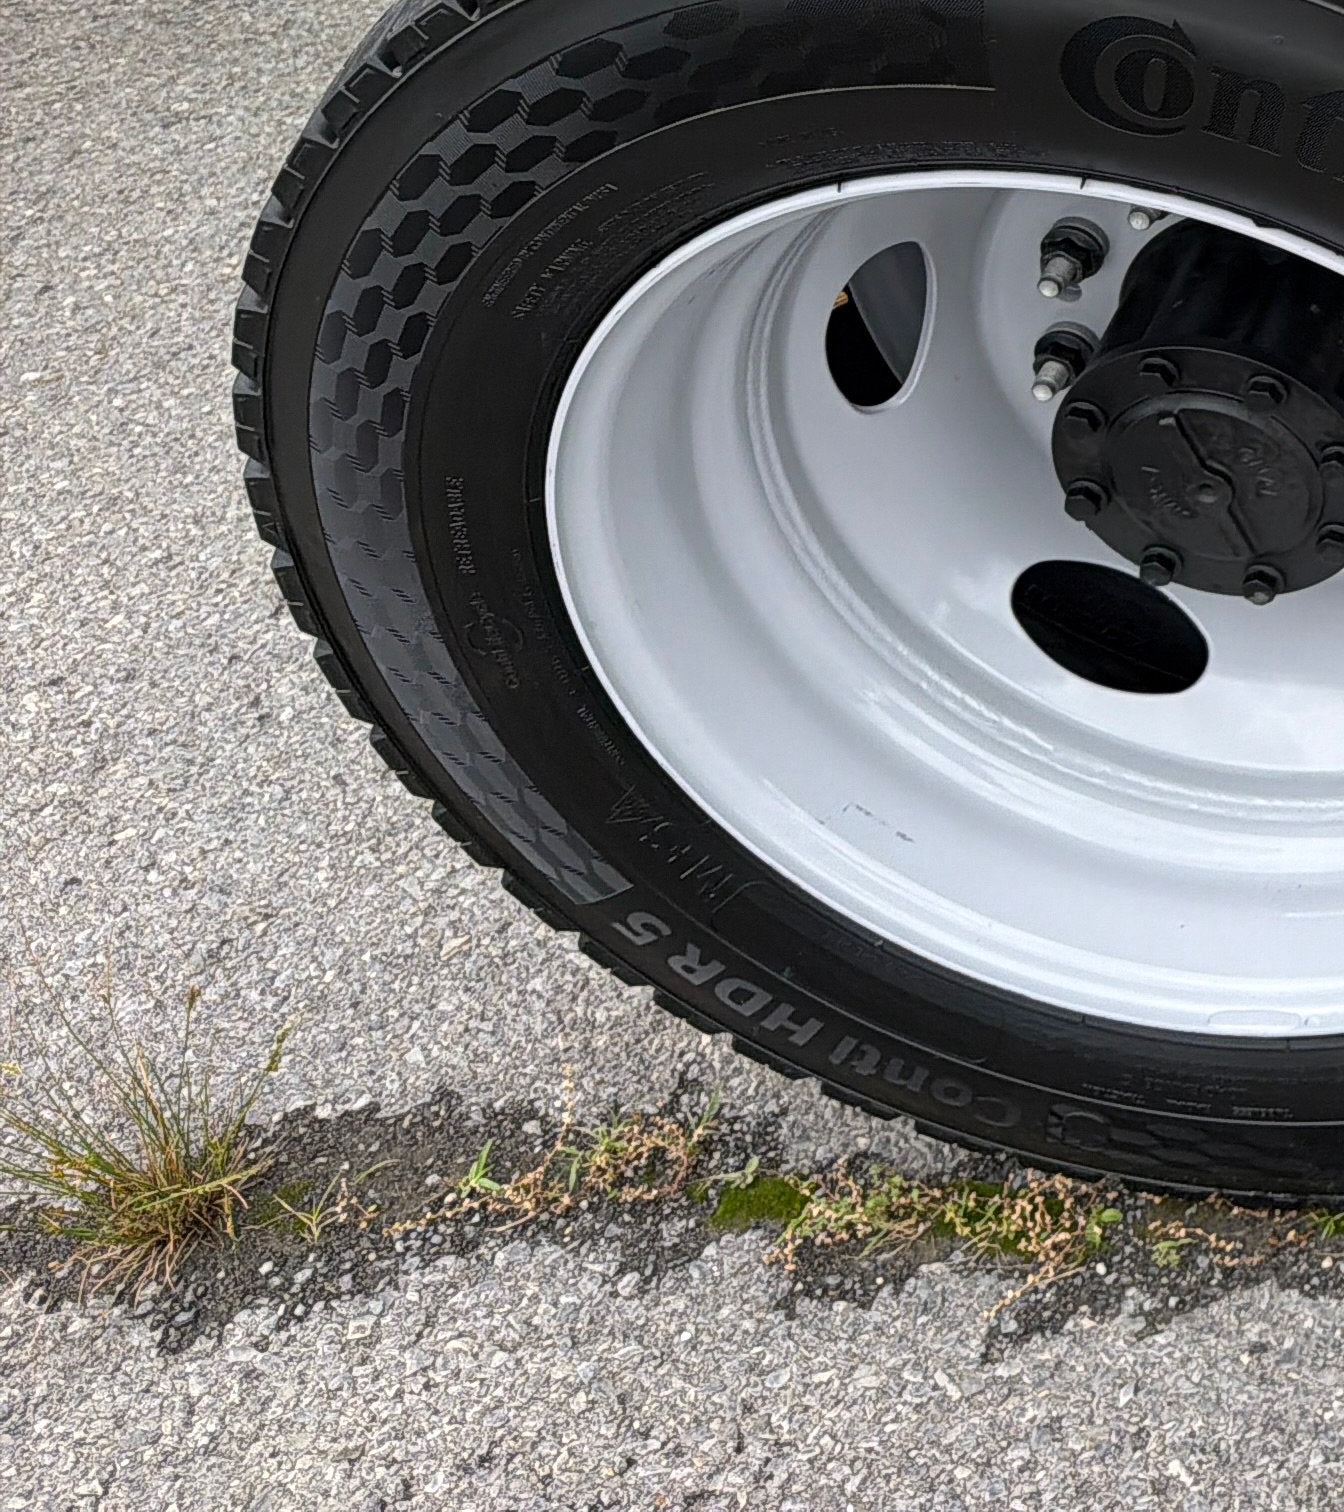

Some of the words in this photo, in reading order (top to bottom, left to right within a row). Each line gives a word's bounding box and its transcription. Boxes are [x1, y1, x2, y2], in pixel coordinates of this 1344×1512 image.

[610, 911, 672, 947] 5
[667, 943, 826, 1047] HDR
[828, 1035, 1021, 1128] Conti
